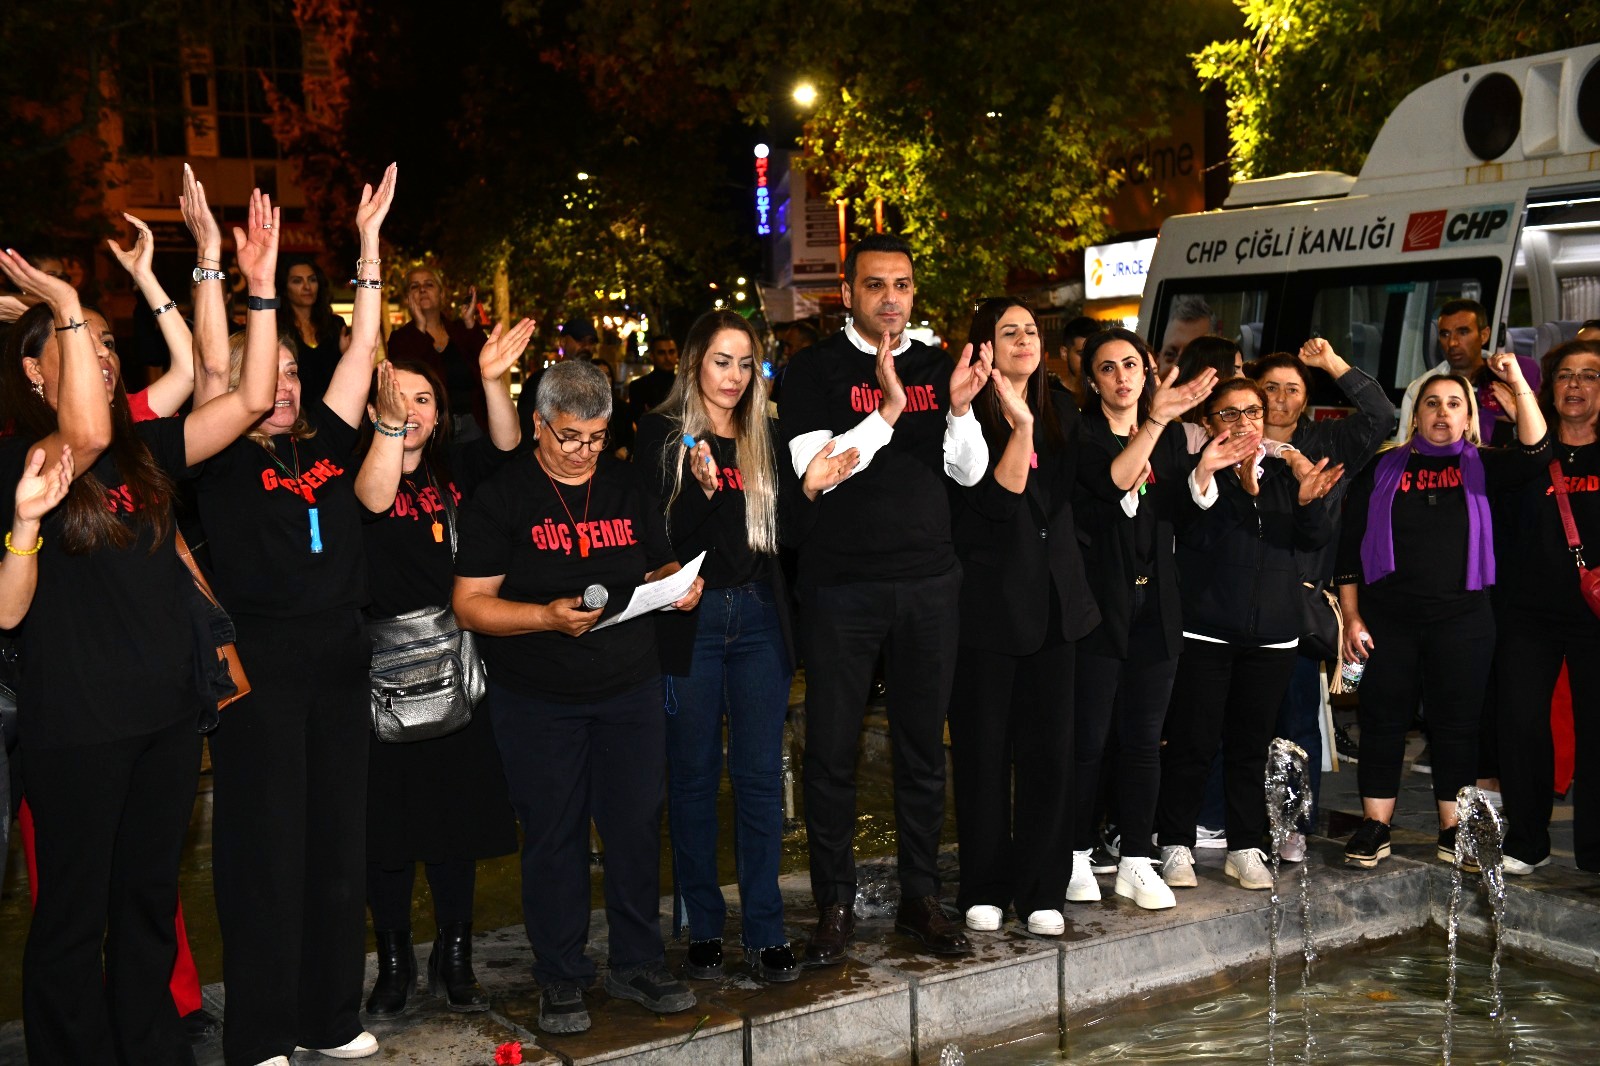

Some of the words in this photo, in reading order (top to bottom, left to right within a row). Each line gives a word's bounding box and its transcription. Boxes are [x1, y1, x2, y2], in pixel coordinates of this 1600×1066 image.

[1186, 240, 1227, 264] CHP
[1235, 227, 1295, 264] ÇİĞLİ
[1298, 216, 1394, 254] KANLIĞI
[1447, 210, 1508, 242] CHP
[903, 384, 939, 413] NDE
[531, 518, 572, 555] GÜÇ
[576, 519, 638, 550] SENDE
